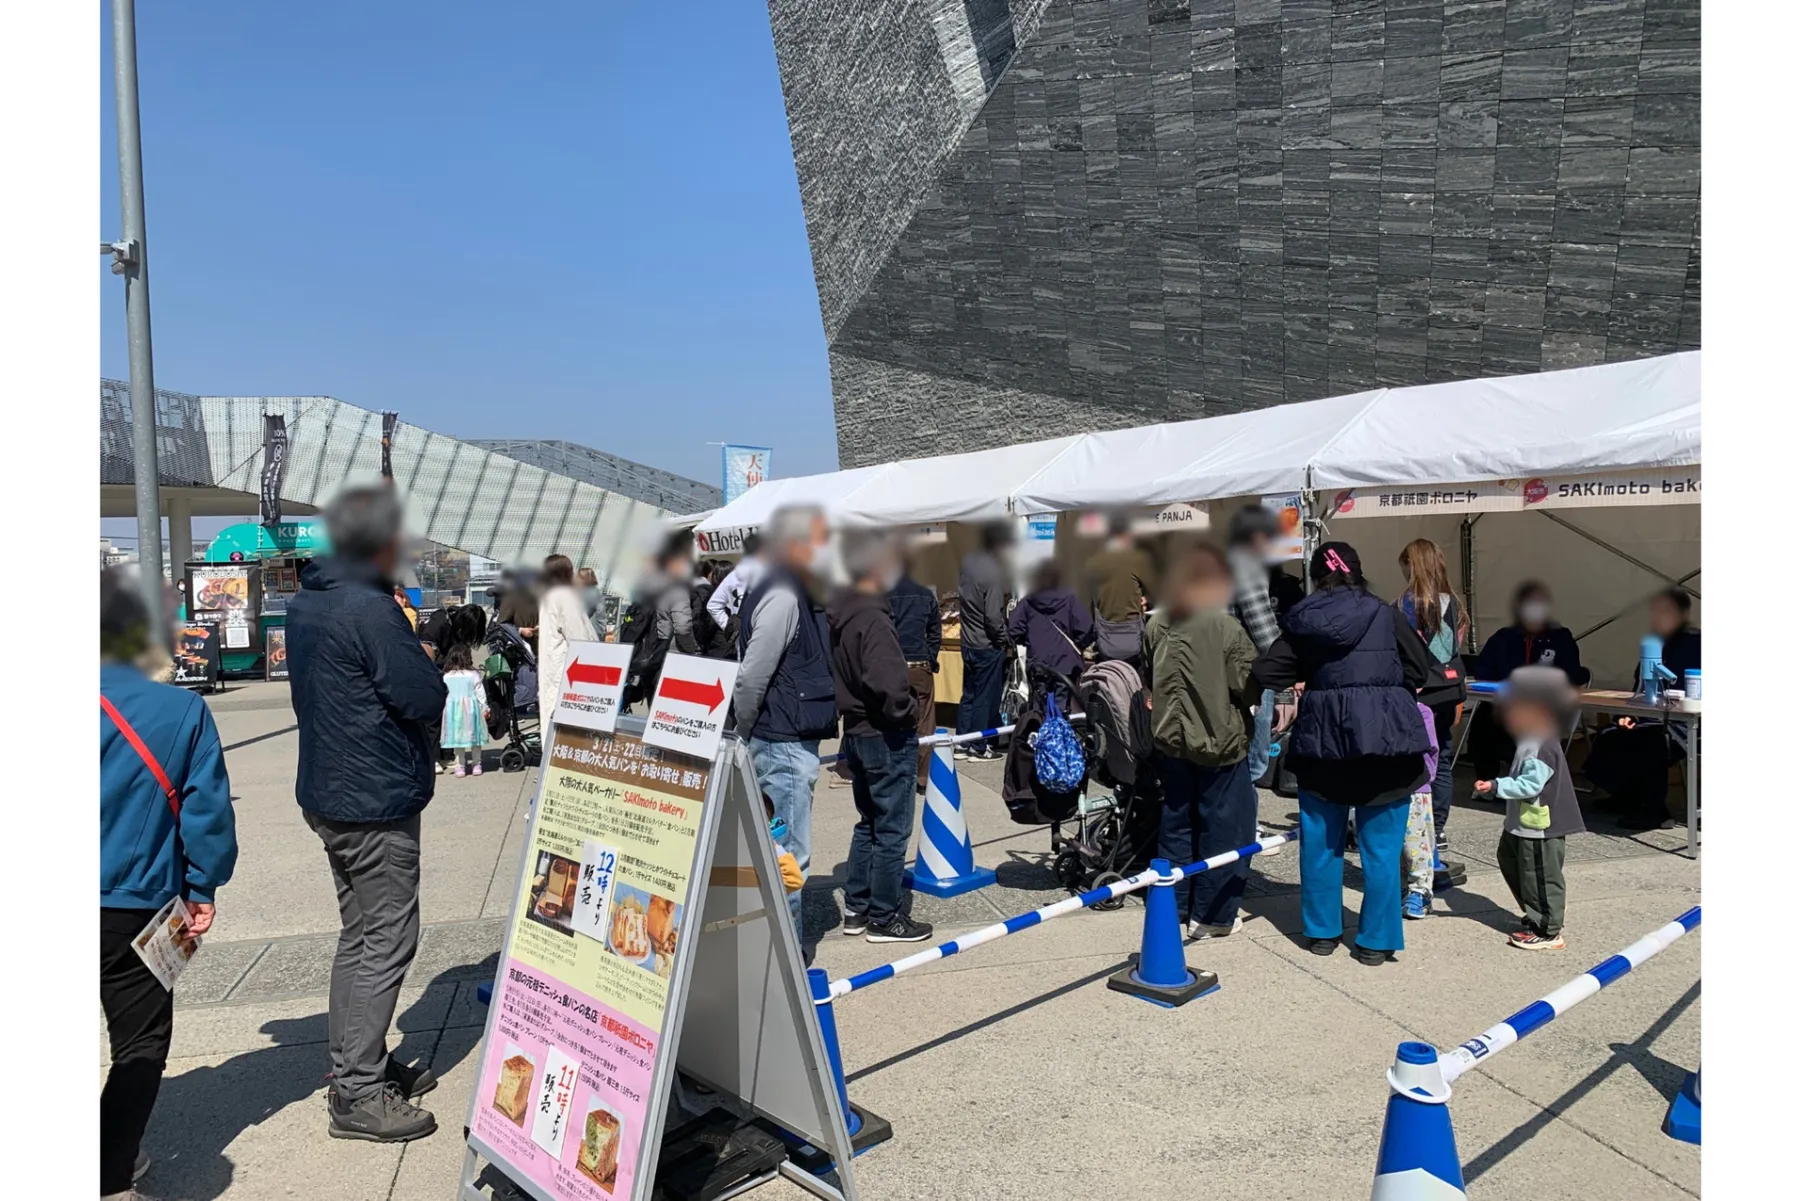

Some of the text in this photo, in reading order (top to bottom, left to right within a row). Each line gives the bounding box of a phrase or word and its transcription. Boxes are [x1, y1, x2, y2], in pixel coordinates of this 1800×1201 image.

[1559, 478, 1701, 498] SAKImoto bak
[1379, 490, 1478, 507] 京都祇園ボロニヤ
[1162, 510, 1192, 523] PANJA
[706, 526, 744, 552] Hotel
